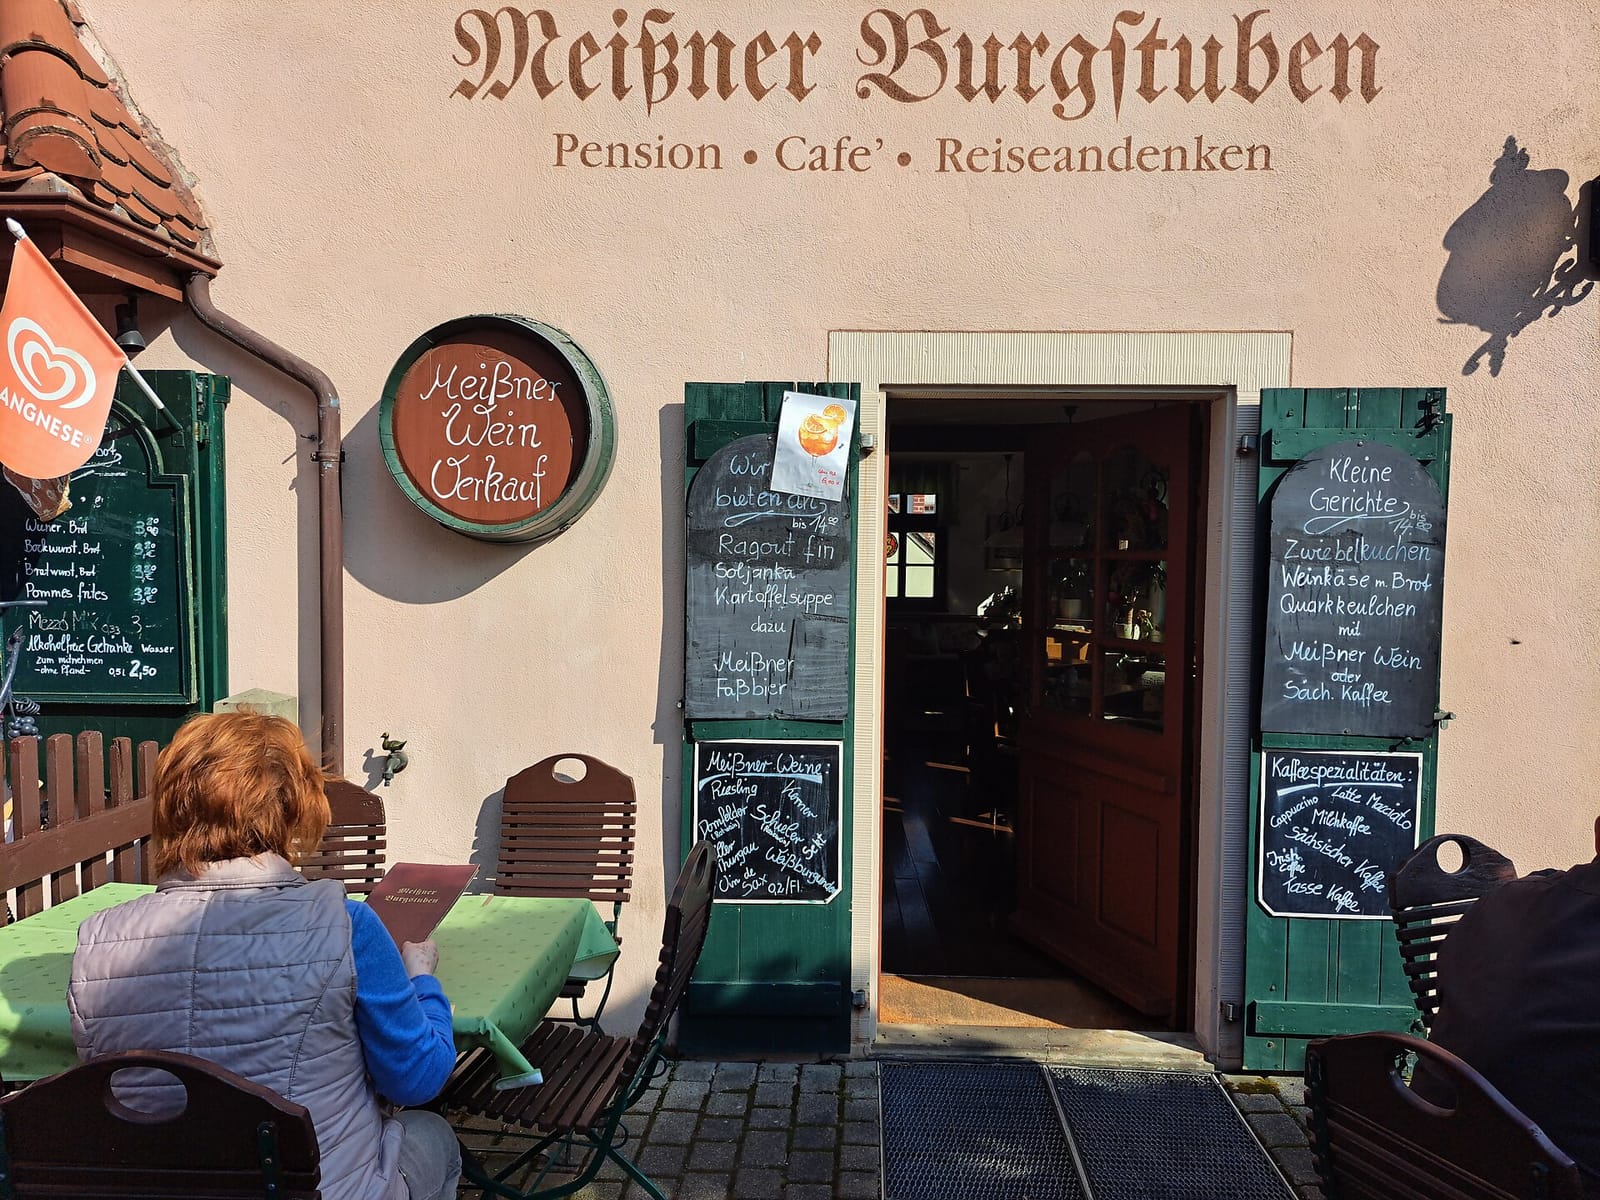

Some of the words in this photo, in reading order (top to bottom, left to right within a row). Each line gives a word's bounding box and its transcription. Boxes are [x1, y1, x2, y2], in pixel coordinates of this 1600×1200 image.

[450, 7, 822, 117] Meißner
[856, 8, 1383, 121] Burgstuben
[553, 133, 723, 170] Pension
[935, 135, 1274, 173] Reiseandenken
[420, 361, 562, 406] Meißner
[442, 403, 541, 448] Wein
[730, 452, 771, 476] Wir
[1329, 455, 1392, 483] Kleine
[431, 454, 548, 508] Verkauf
[715, 485, 782, 507] bieten
[1310, 487, 1398, 512] Gerichte
[792, 518, 807, 529] bis
[1409, 510, 1428, 522] bis
[718, 532, 796, 562] Ragout
[804, 534, 835, 564] fin
[1284, 535, 1431, 563] Zwiebelkuchen
[715, 561, 796, 585] Soljanka
[1282, 564, 1370, 588] Weinkäse
[1375, 578, 1388, 588] m.
[1392, 572, 1432, 592] Brot
[25, 582, 73, 599] Pommes
[77, 581, 108, 603] frites
[715, 584, 833, 614] Kartoffelsuppe
[1280, 593, 1416, 617] Quarkkeulchen
[750, 615, 786, 633] dazu
[1338, 620, 1361, 637] mit
[26, 634, 85, 654] Alkoholfreie
[141, 644, 175, 654] Wasser
[1284, 640, 1366, 668] Meißner
[1374, 645, 1422, 670] Wein
[36, 656, 55, 665] zum
[58, 654, 104, 665] mitnehmen
[129, 659, 157, 680] 2,50
[714, 651, 795, 677] Meißner
[1331, 668, 1361, 683] oder
[716, 678, 788, 702] Faßbier
[1342, 682, 1392, 708] Kaffee
[706, 751, 773, 778] Meißner
[1272, 756, 1413, 787] Kaffeespezialitäten:
[711, 778, 758, 803] Riesling
[781, 779, 818, 818] Kerner
[1331, 786, 1362, 803] Latte
[1311, 808, 1371, 837] Milchkaffee
[713, 840, 735, 859] ller
[802, 833, 827, 860] Sekt
[719, 874, 741, 893] Vin
[742, 873, 768, 897] Sax
[743, 867, 757, 880] de
[1354, 858, 1386, 893] Kaffee
[1282, 876, 1323, 894] Tasse
[1326, 884, 1360, 913] Kaffee
